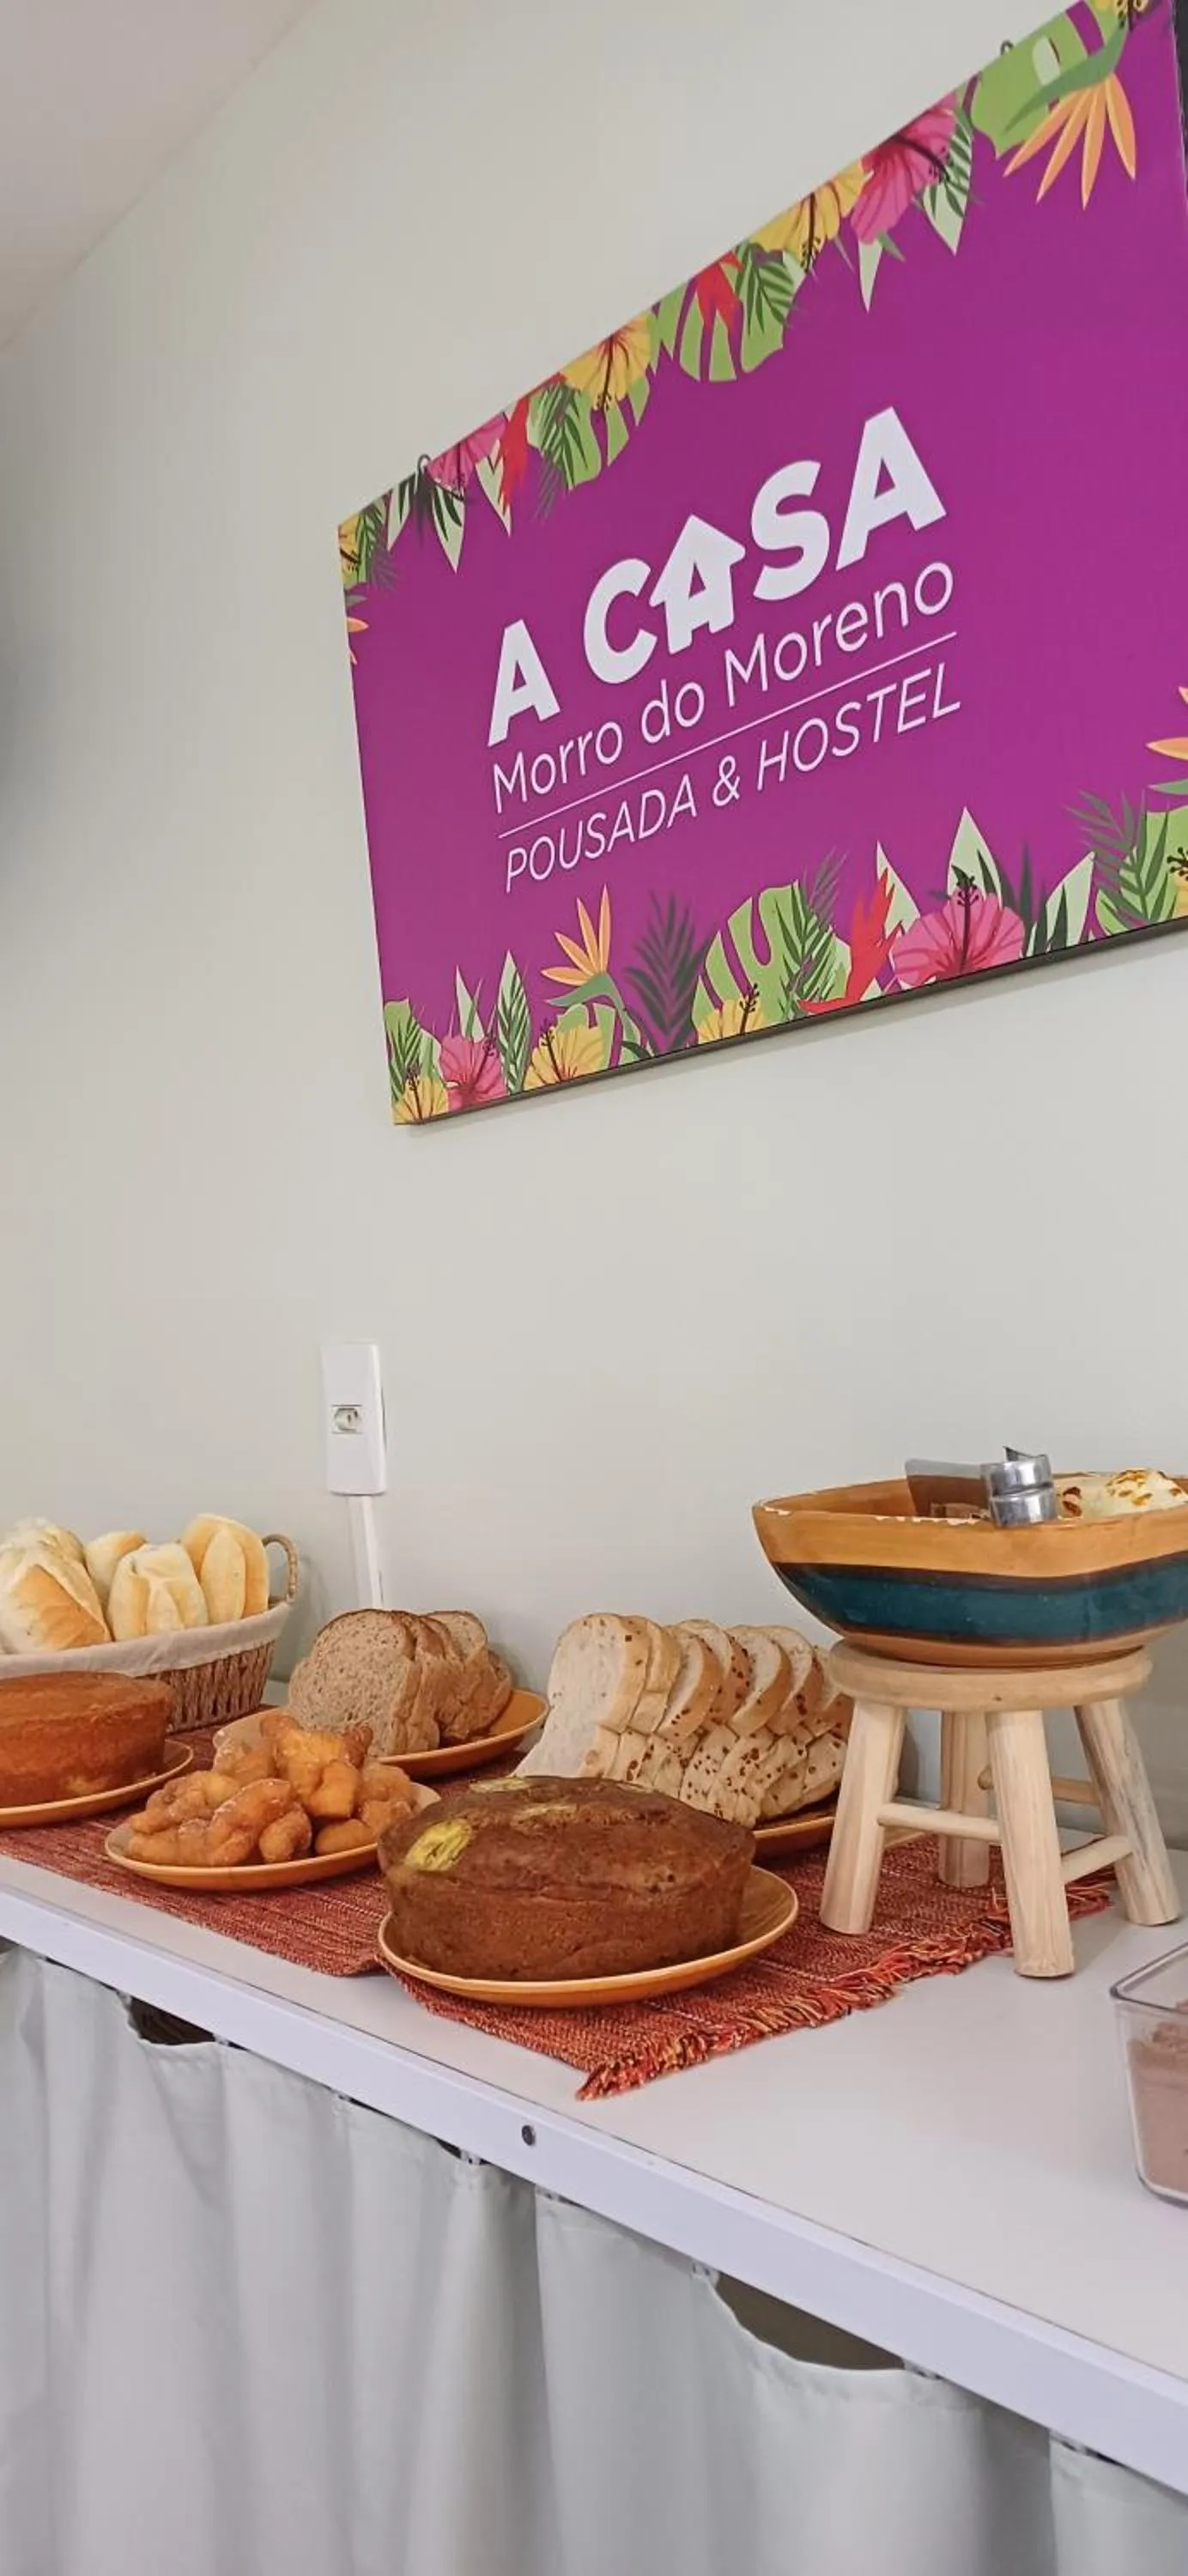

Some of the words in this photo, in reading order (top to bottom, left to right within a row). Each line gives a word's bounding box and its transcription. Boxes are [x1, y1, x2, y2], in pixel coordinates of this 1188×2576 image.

[488, 619, 561, 747] A
[583, 406, 947, 684] CASA
[493, 721, 622, 814] Morro
[641, 679, 705, 744] do
[725, 562, 954, 707] Moreno
[506, 774, 697, 893] POUSADA
[712, 755, 741, 806] &
[757, 663, 961, 791] HOSTEL
